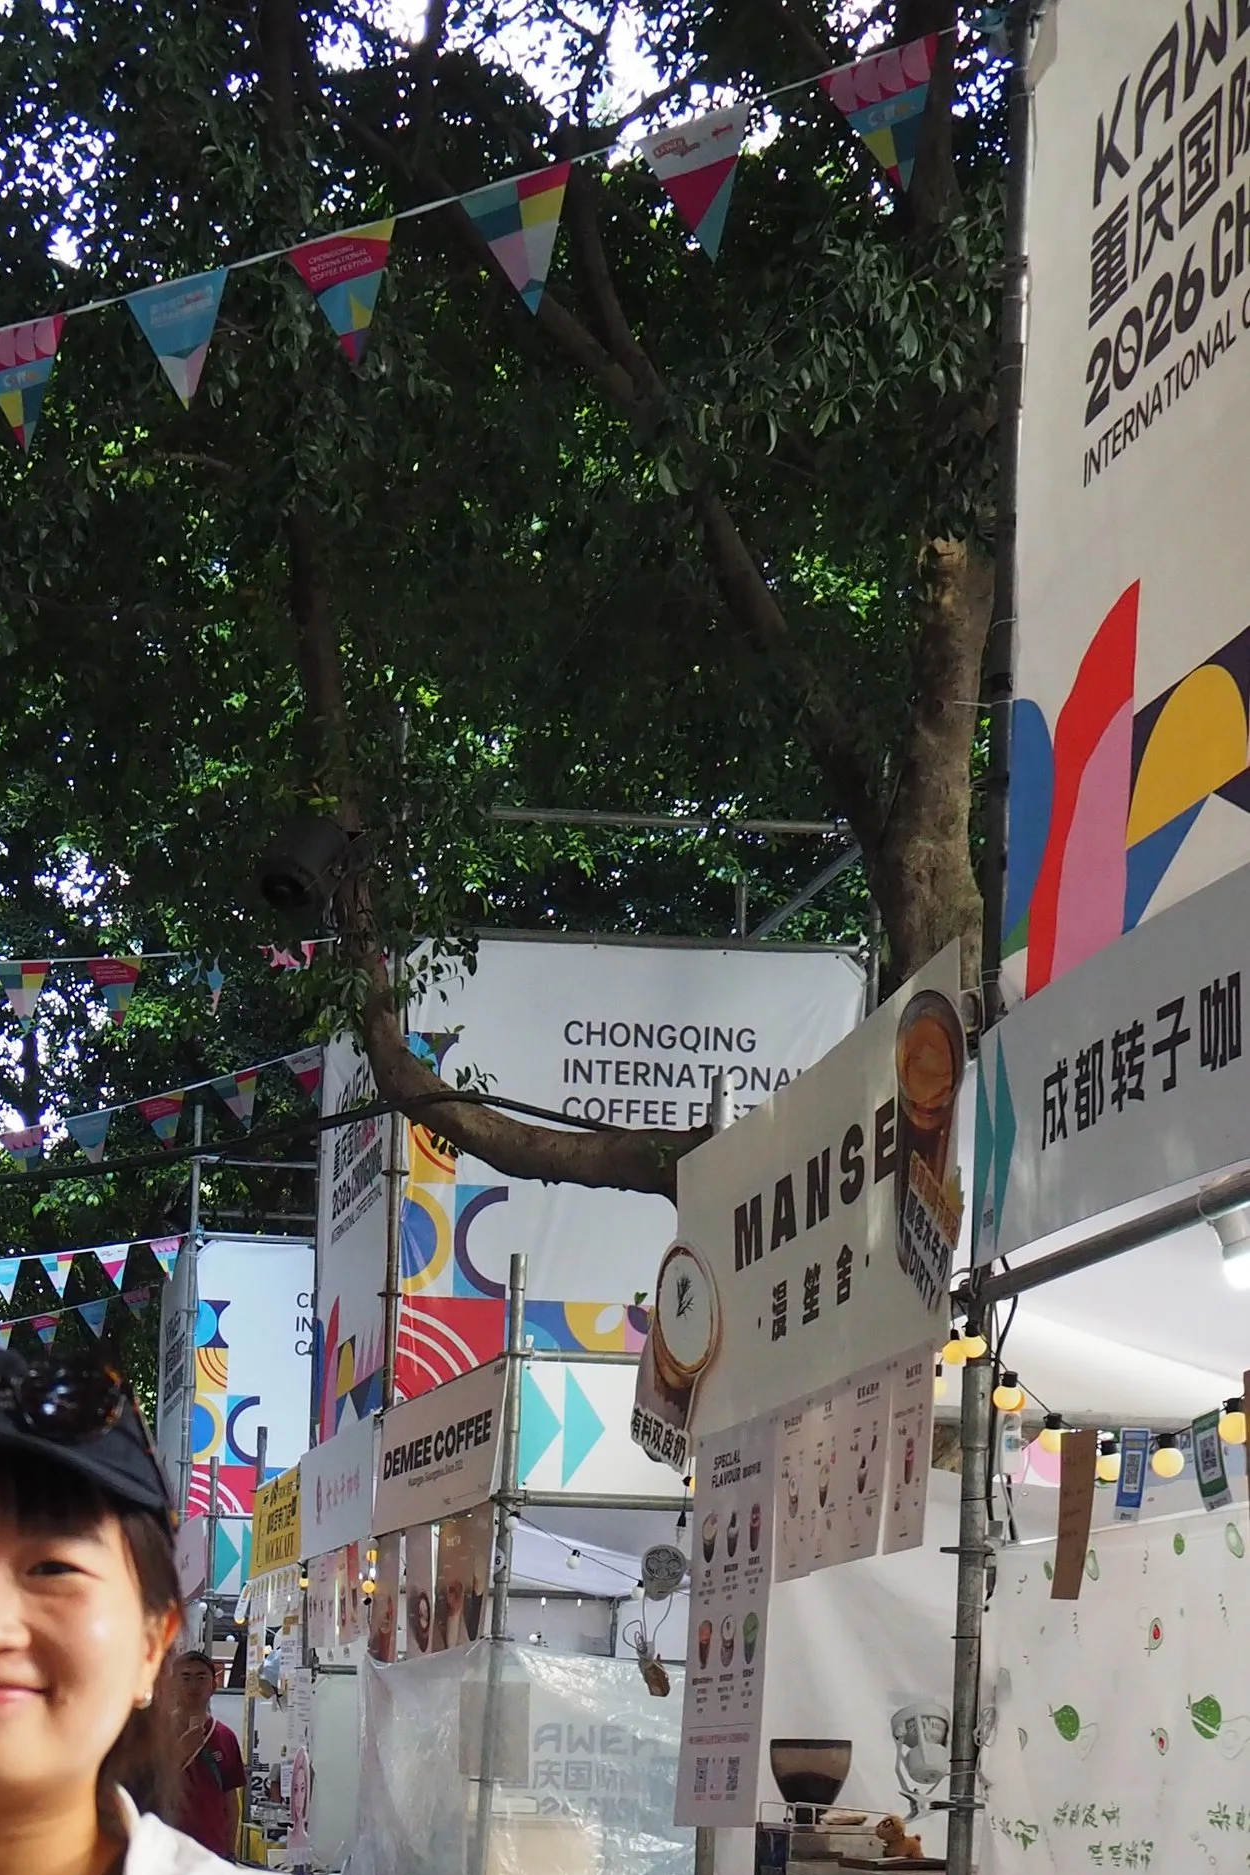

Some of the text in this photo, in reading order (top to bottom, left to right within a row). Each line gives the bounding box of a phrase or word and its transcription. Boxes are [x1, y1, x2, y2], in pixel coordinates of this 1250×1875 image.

[1083, 310, 1237, 488] INTERNATIONAL
[563, 1020, 757, 1054] CHONGQING
[1041, 970, 1242, 1151] 成都转子咖
[562, 1057, 803, 1093] INTERNATONA
[562, 1096, 677, 1127] COFFEE
[733, 1096, 898, 1273] MANSE
[908, 1244, 938, 1311] DIRTY
[383, 1434, 432, 1481] DEMEE
[433, 1408, 493, 1462] COFFEE
[711, 1467, 741, 1490] FLAVOUR
